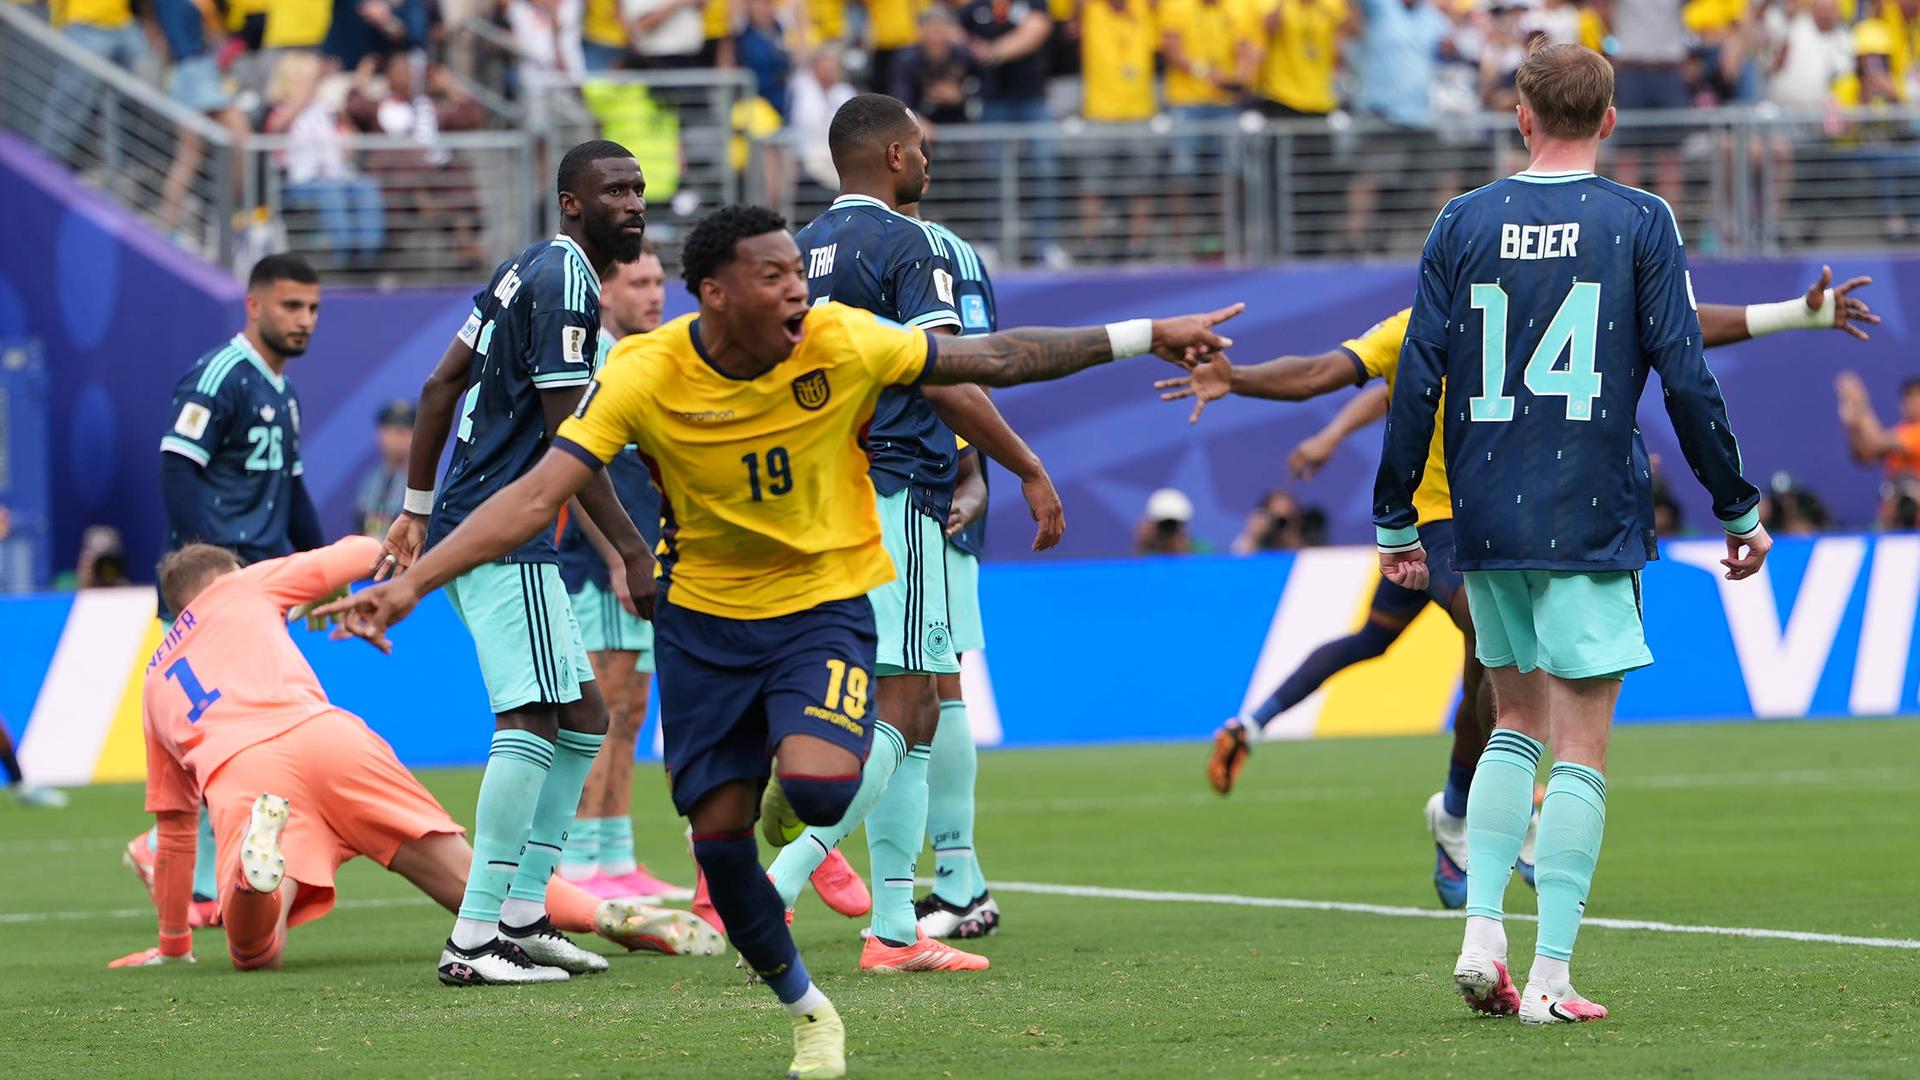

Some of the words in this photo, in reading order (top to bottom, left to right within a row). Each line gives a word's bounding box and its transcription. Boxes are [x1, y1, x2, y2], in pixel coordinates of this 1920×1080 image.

[808, 243, 838, 279] TAH
[1500, 222, 1580, 260] BEIER
[1469, 281, 1602, 422] 14
[245, 425, 284, 471] 26
[741, 446, 794, 502] 19
[1665, 535, 1920, 718] VI
[164, 656, 222, 724] 1
[824, 659, 869, 720] 19
[803, 705, 865, 737] marathon
[934, 830, 961, 844] DFB
